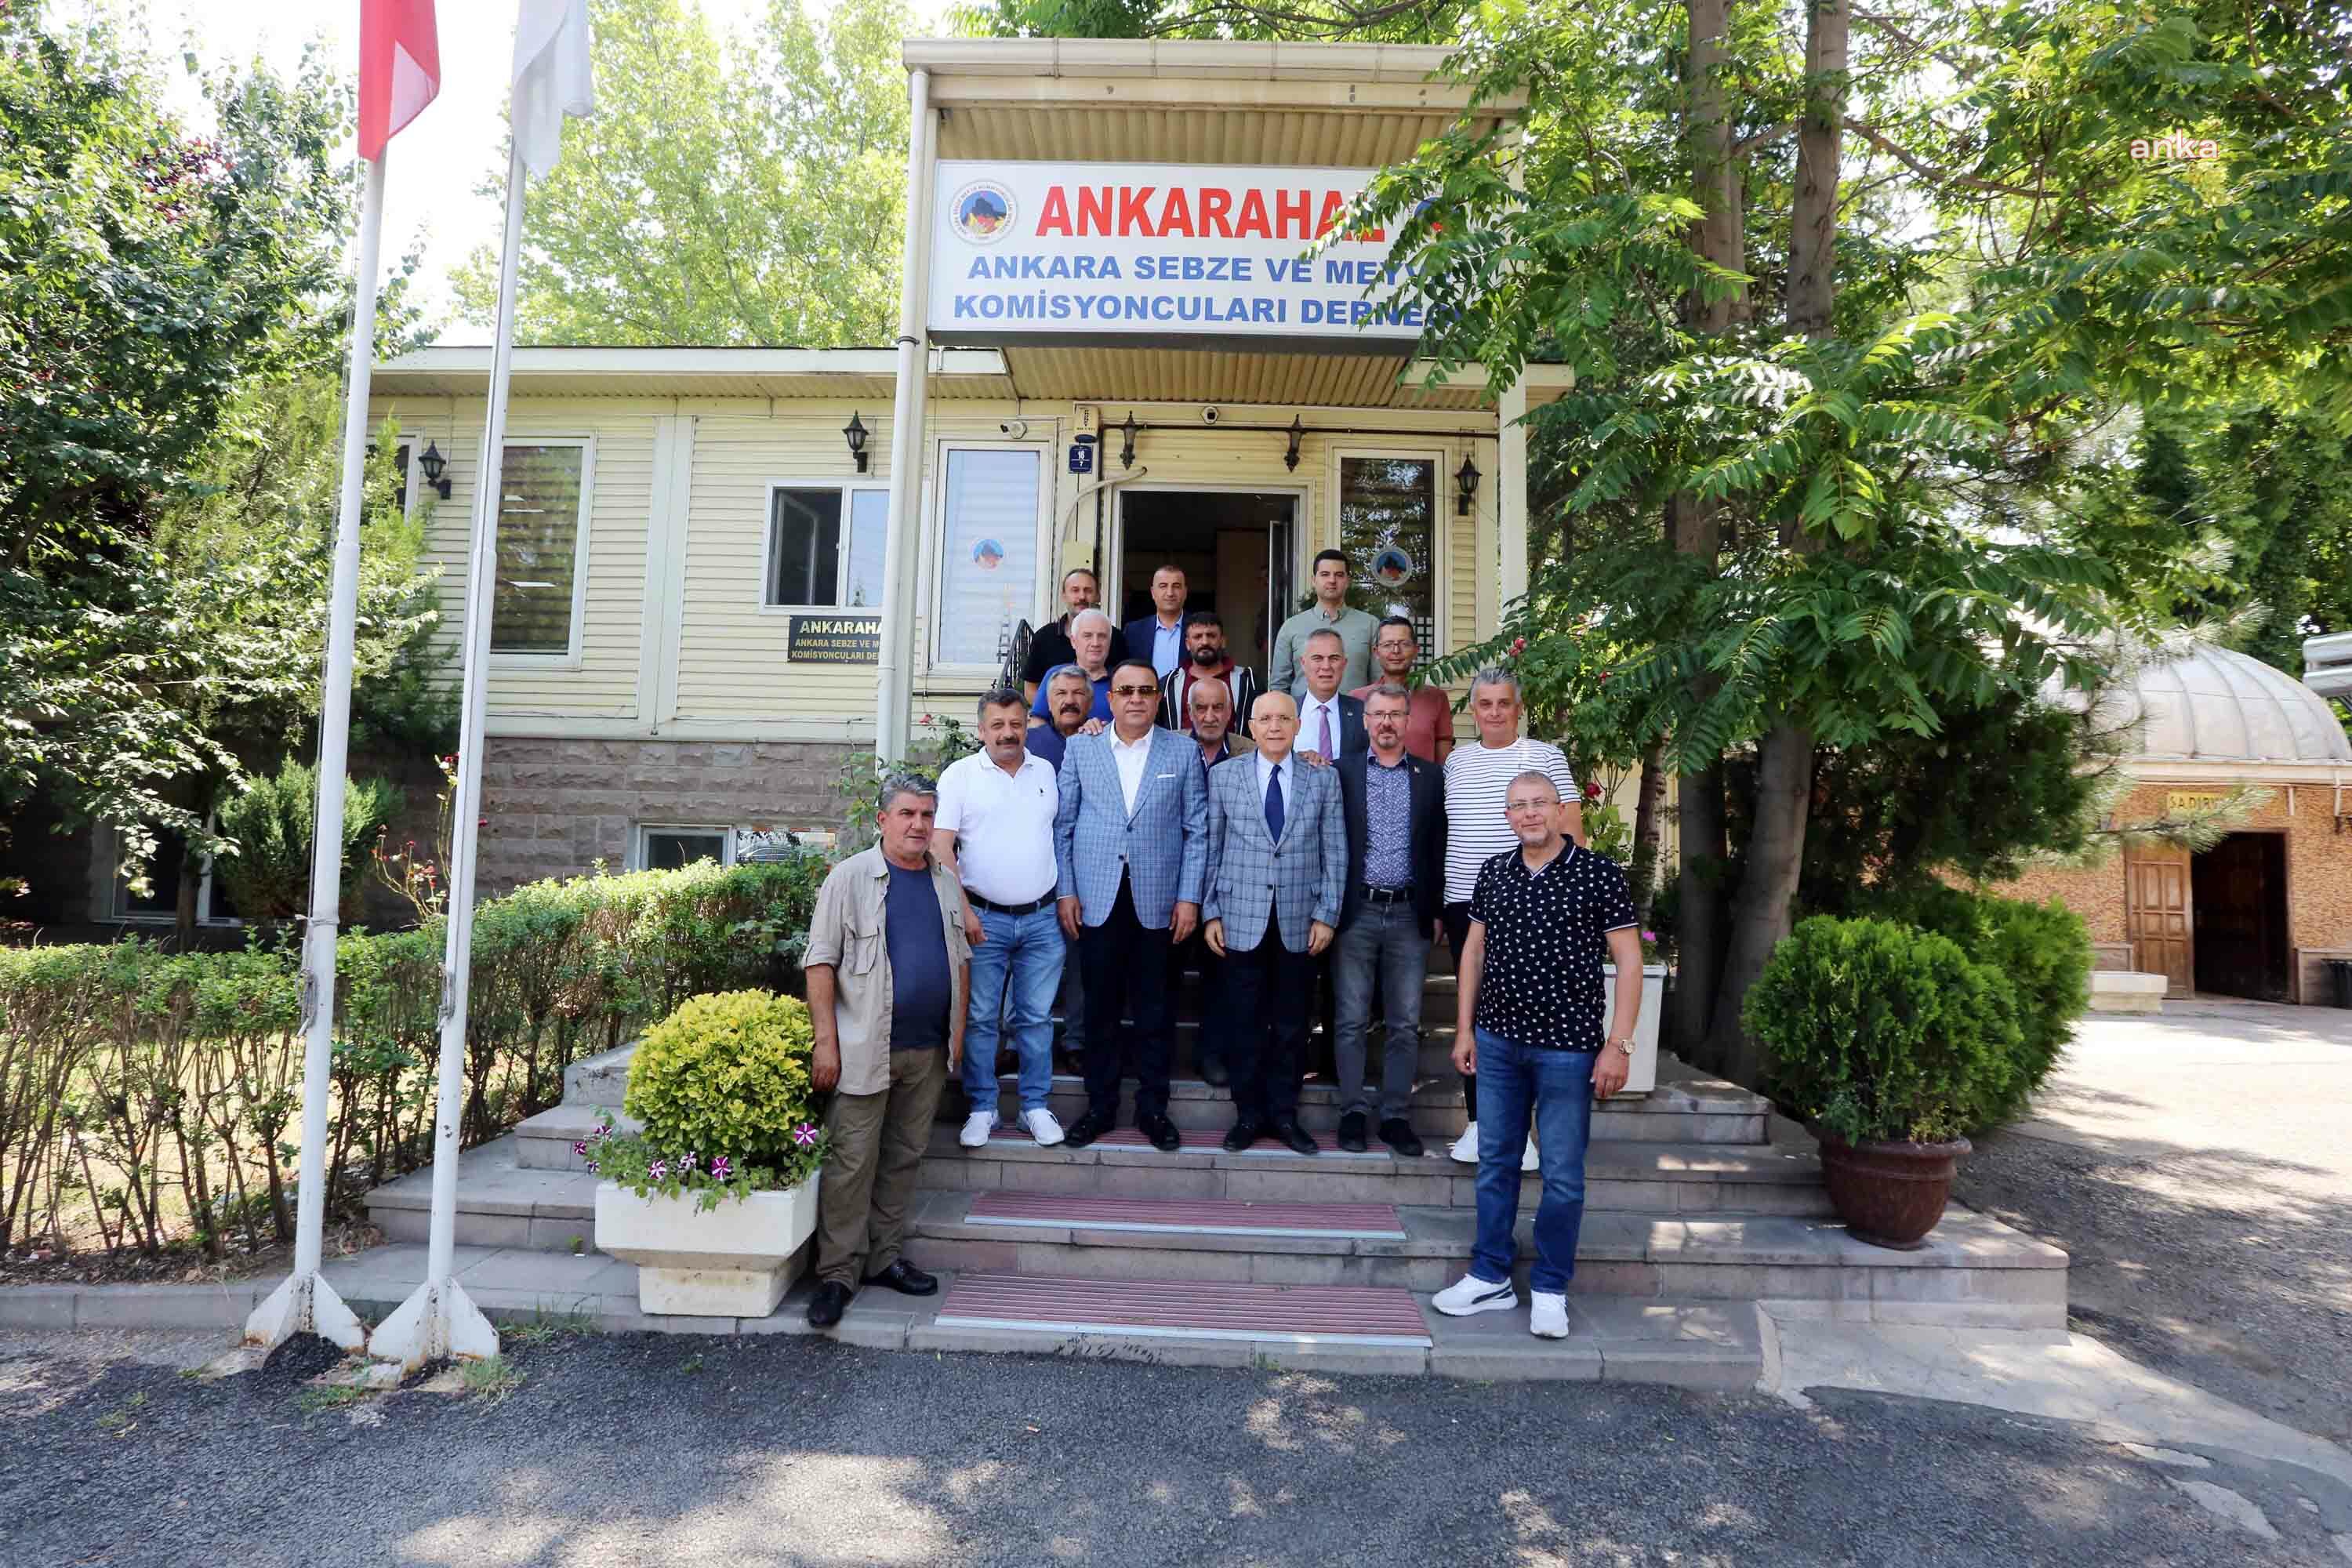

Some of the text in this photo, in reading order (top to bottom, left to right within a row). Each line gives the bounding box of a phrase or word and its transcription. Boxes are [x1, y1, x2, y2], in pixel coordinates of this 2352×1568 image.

[967, 256, 1121, 279] ANKARA
[1134, 256, 1252, 281] SEBZE
[1265, 258, 1312, 283] VE
[953, 289, 1287, 323] KOMİSYONCULARI
